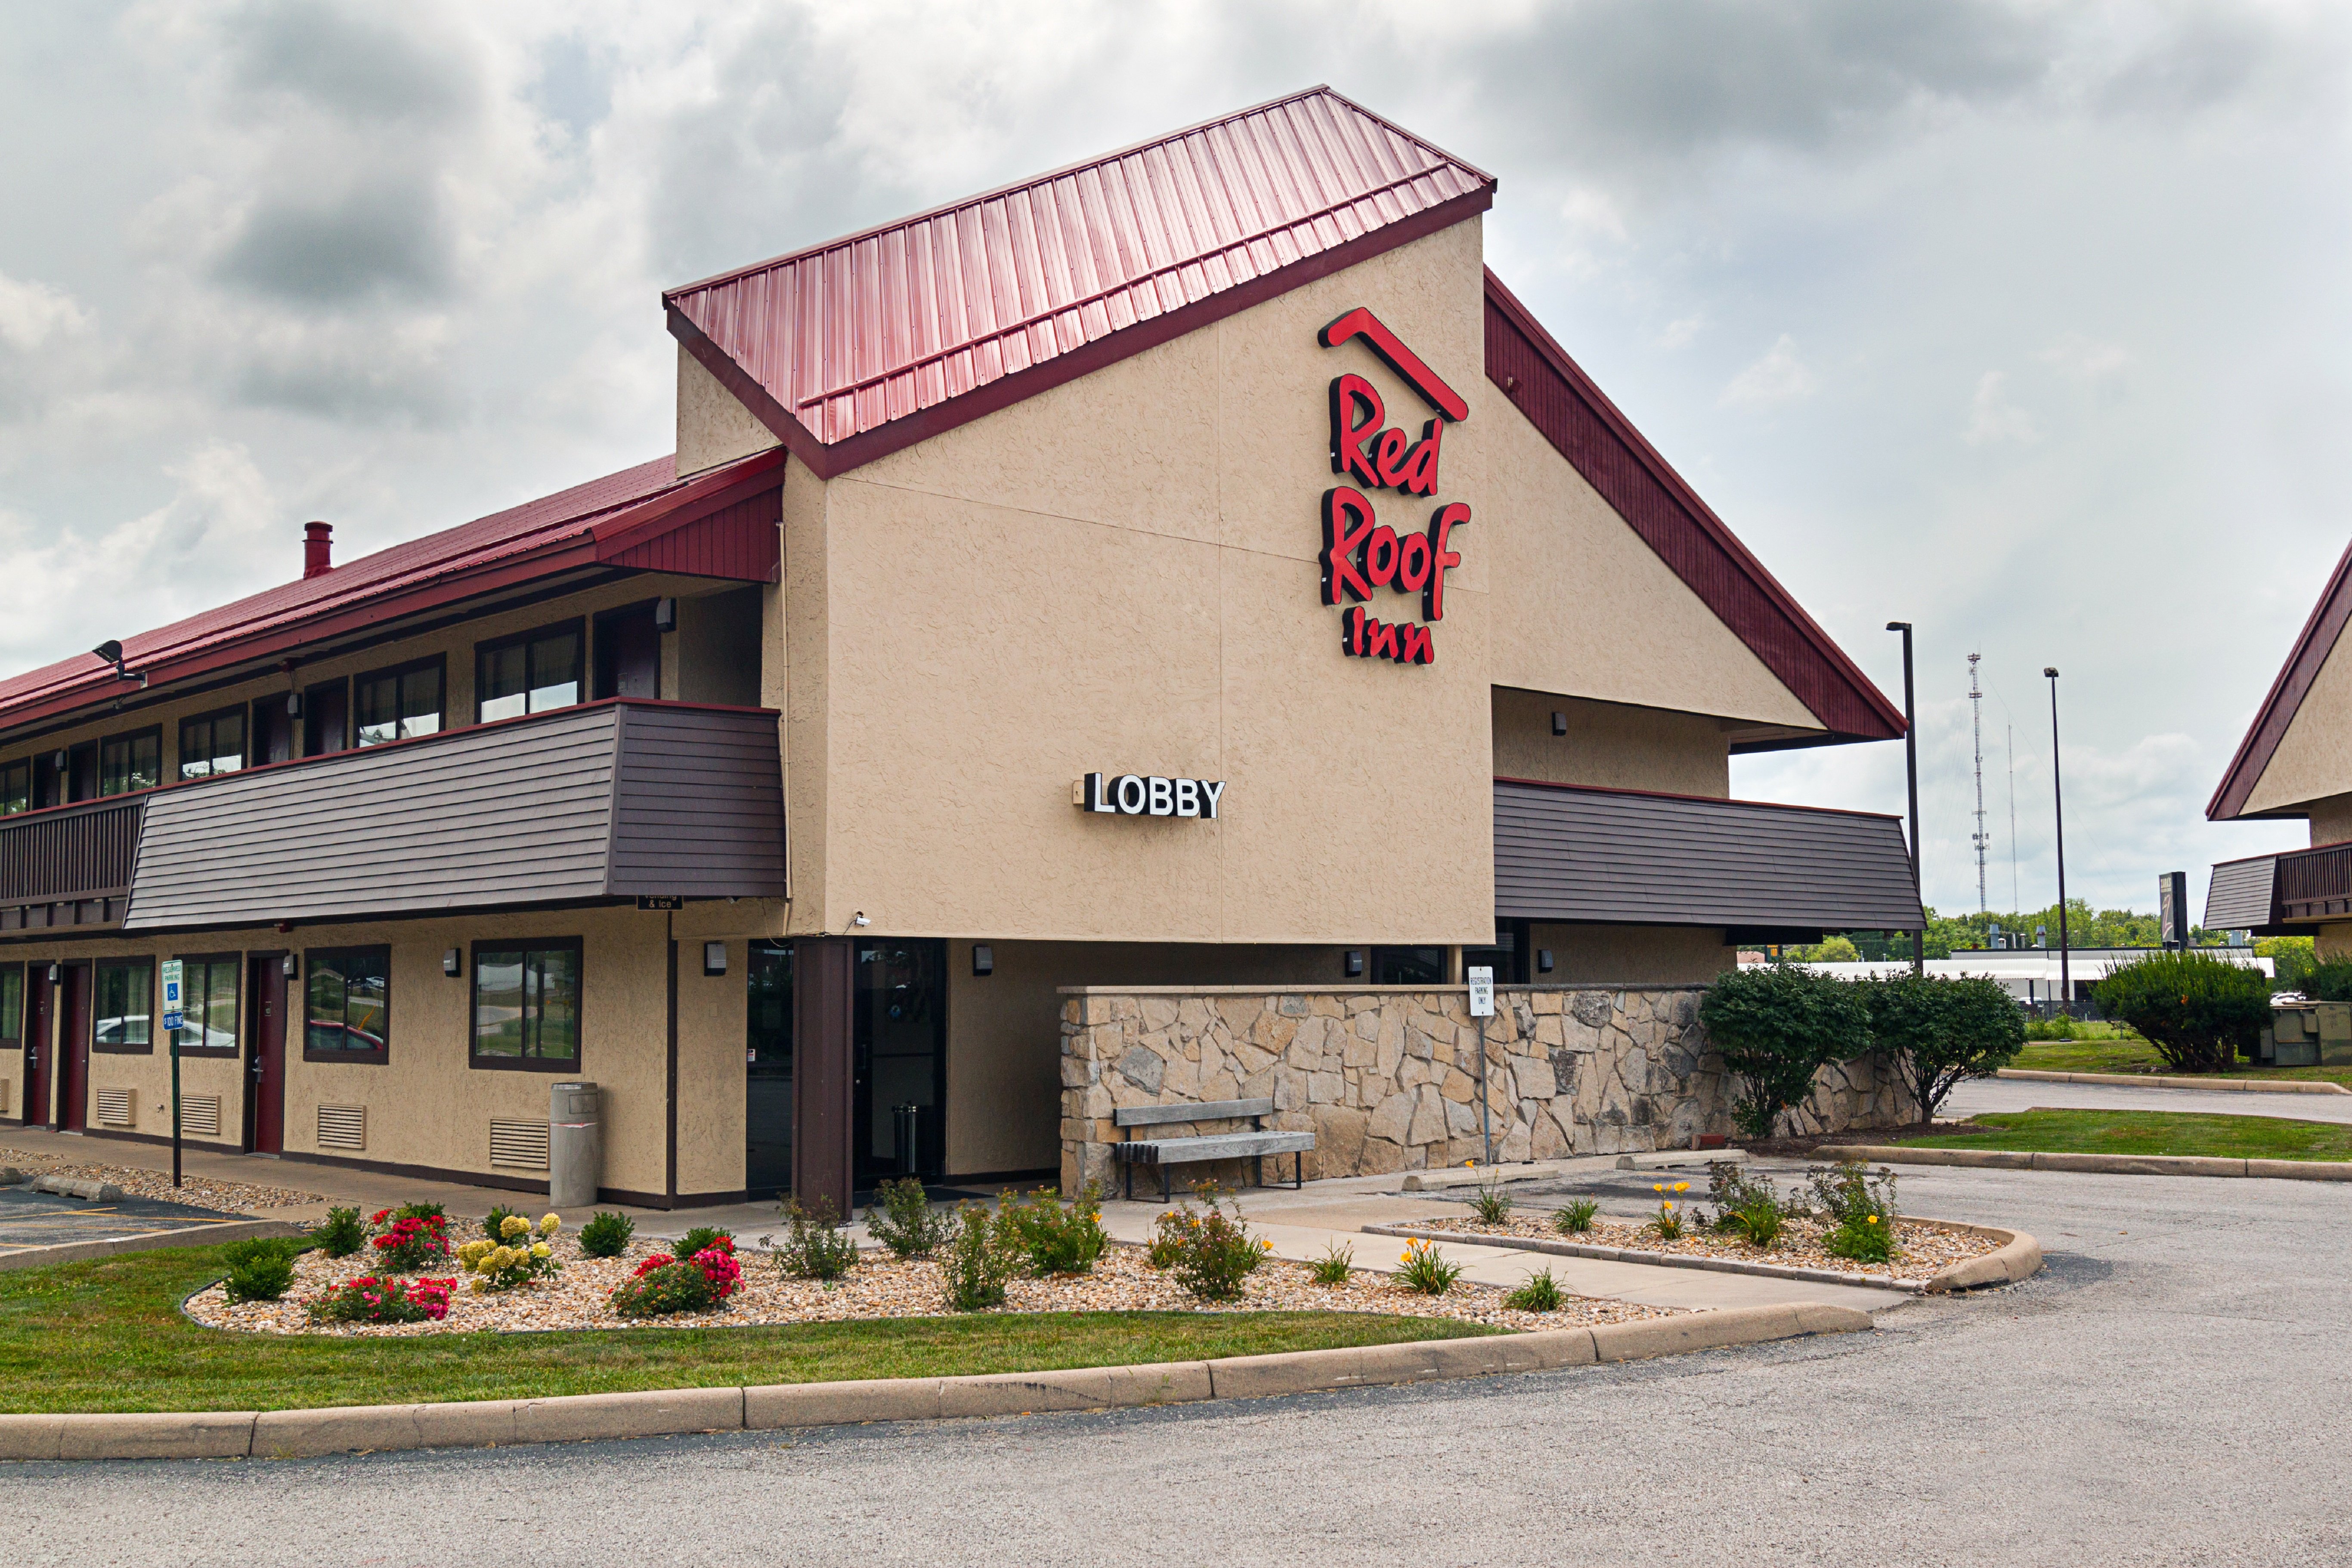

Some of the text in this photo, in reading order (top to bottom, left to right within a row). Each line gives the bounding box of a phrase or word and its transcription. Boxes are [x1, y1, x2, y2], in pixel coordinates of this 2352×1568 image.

[1330, 373, 1443, 496] Red
[1320, 486, 1471, 621] Roof
[1343, 606, 1434, 664] Inn
[1084, 772, 1226, 818] LOBBY
[1475, 987, 1488, 995] PARKING
[164, 1017, 173, 1026] $100
